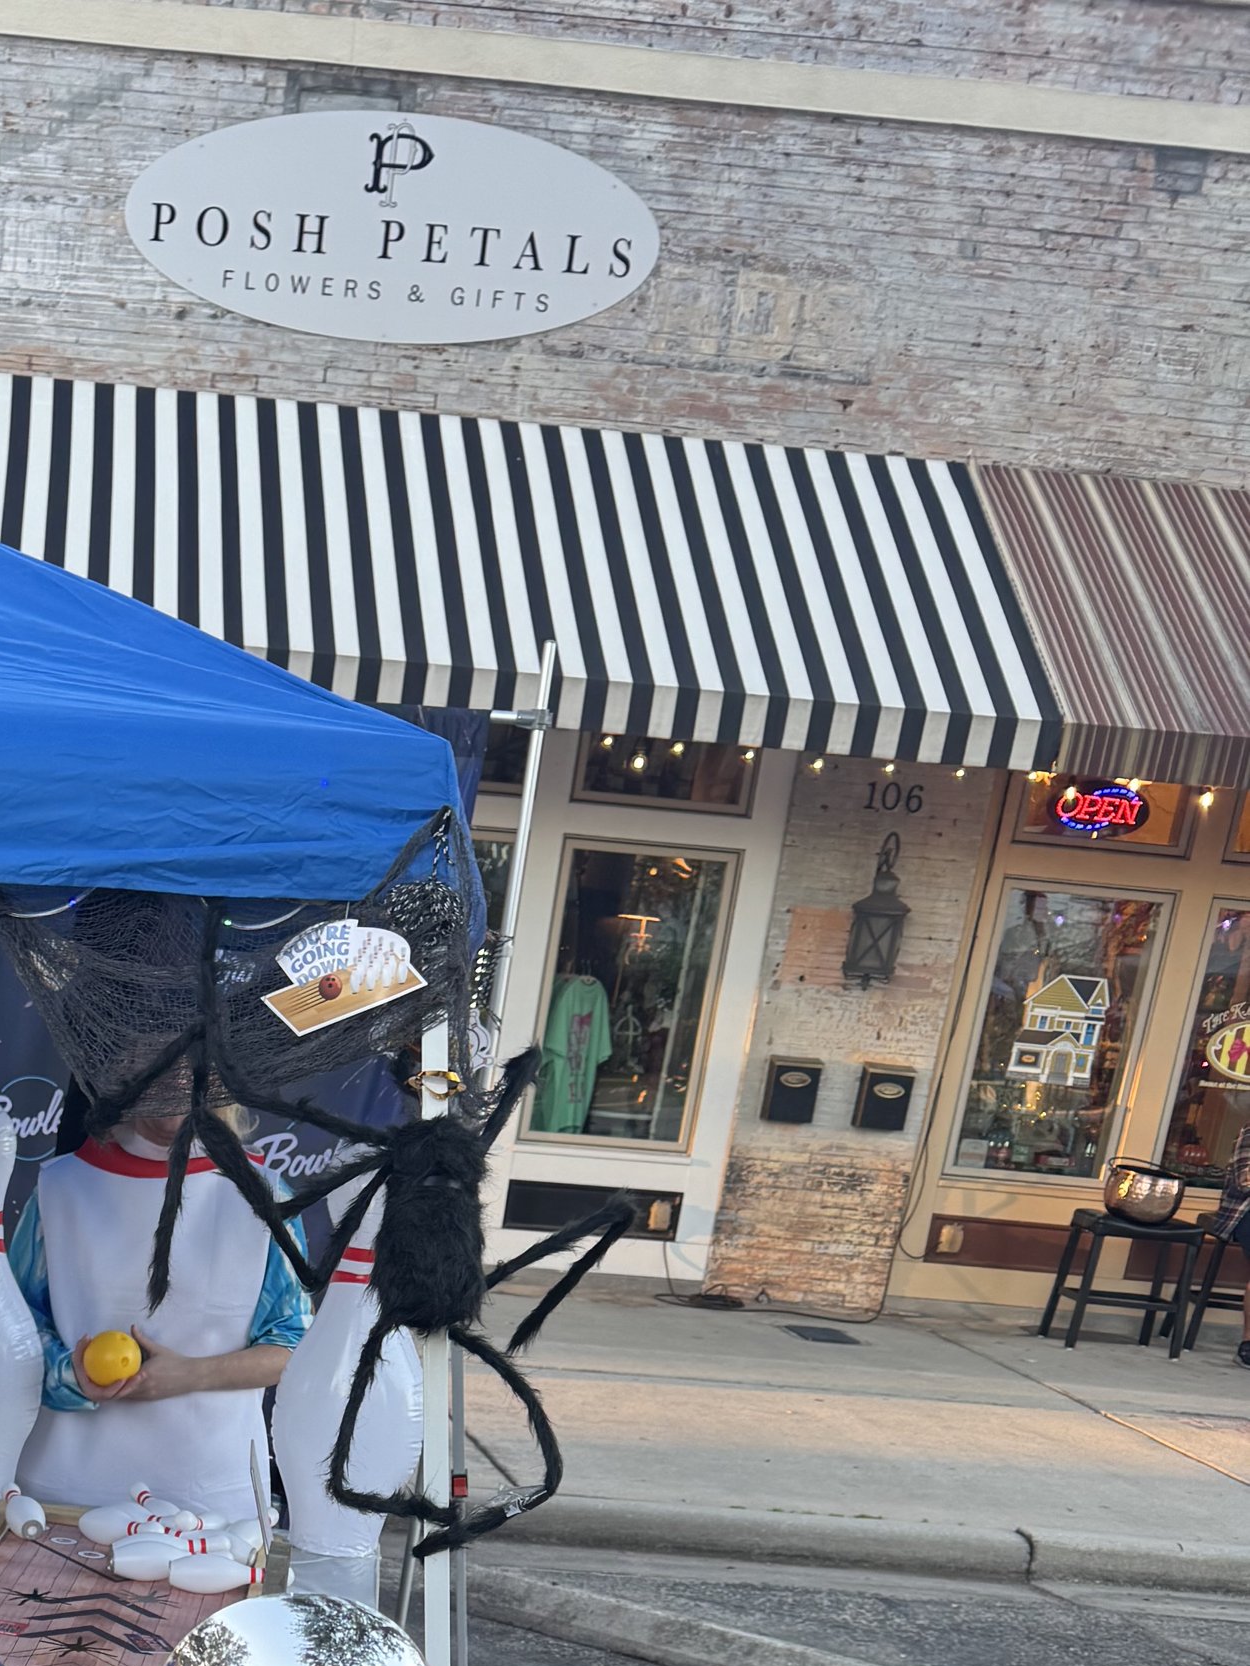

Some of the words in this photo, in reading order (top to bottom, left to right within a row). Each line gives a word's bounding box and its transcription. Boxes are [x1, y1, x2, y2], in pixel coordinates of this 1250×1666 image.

[150, 202, 331, 256] POSH
[376, 218, 635, 279] PETALS
[222, 269, 383, 301] FLOWERS
[407, 284, 426, 304] &
[450, 287, 551, 314] GIFTS
[863, 781, 925, 814] 106
[1055, 790, 1143, 826] OPEN
[290, 941, 350, 974] GOING
[295, 958, 349, 988] DOWN
